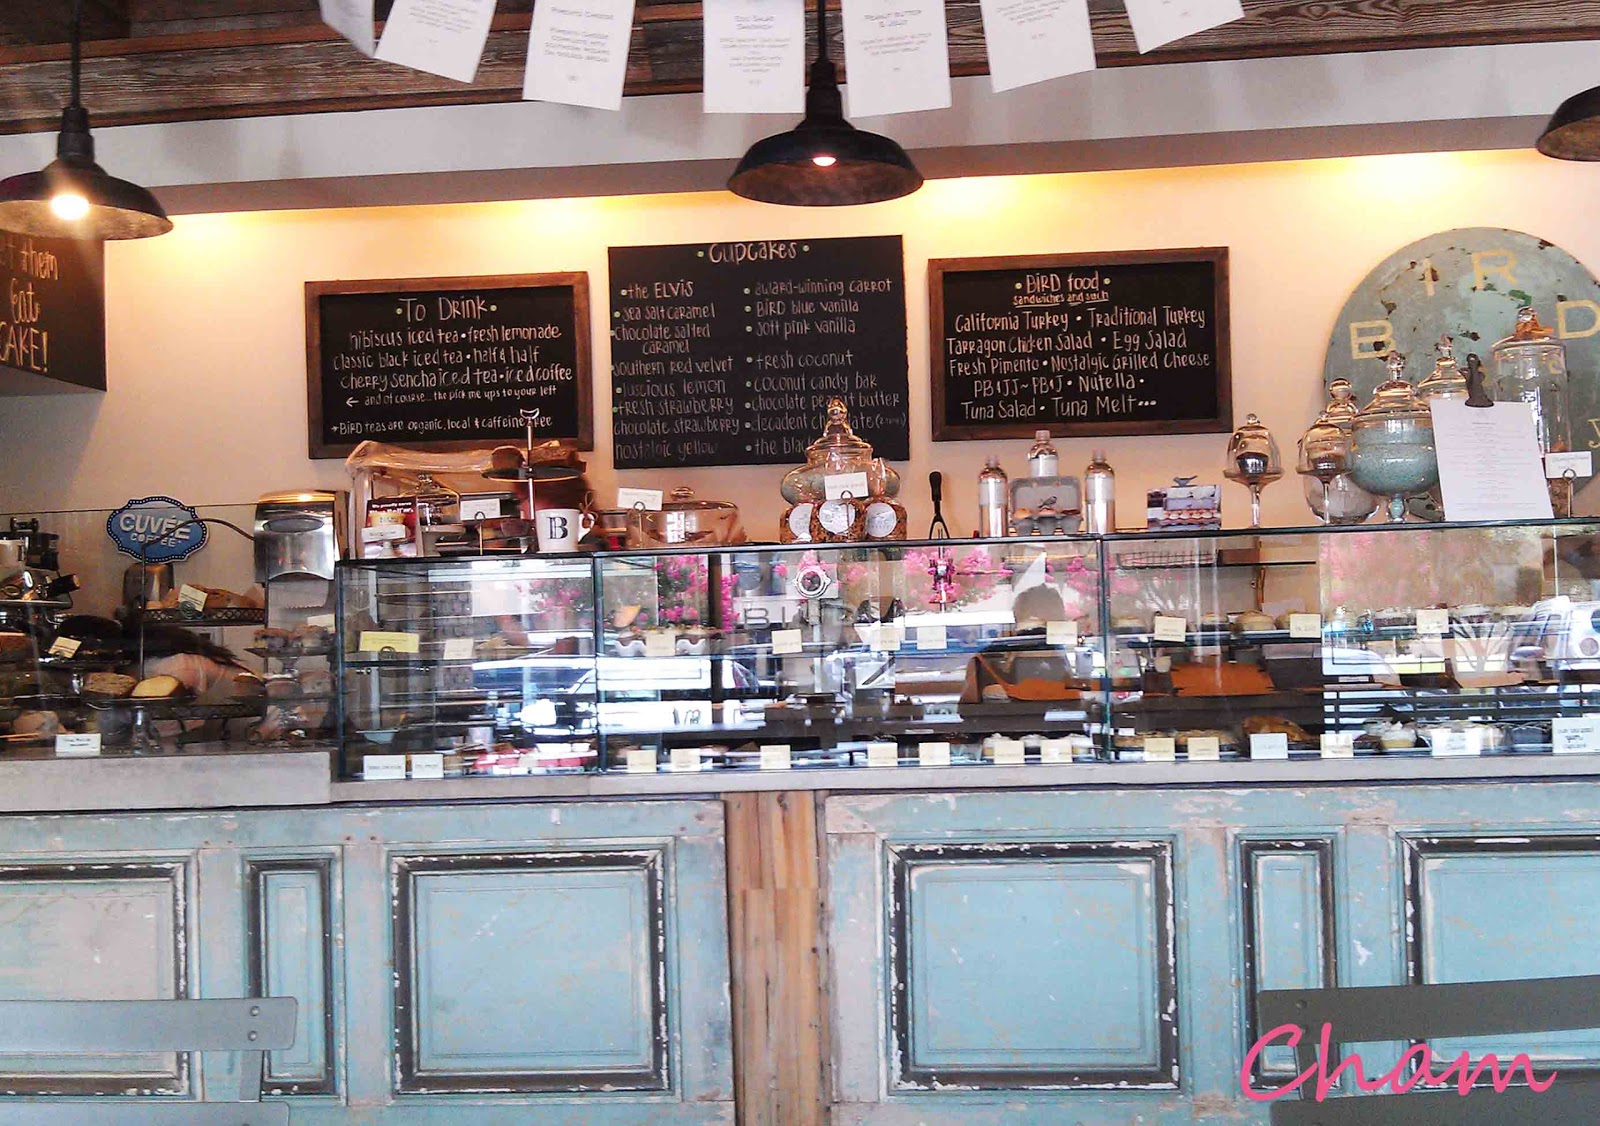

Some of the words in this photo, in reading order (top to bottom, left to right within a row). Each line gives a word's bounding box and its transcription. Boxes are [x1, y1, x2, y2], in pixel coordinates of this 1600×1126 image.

[627, 282, 650, 299] the
[849, 277, 893, 294] carrot
[1066, 271, 1100, 292] food
[791, 299, 816, 315] blue
[819, 299, 860, 315] vanilla
[1013, 292, 1065, 306] sandwiches
[1067, 291, 1084, 304] and
[399, 298, 427, 323] To
[621, 305, 641, 322] sea
[644, 304, 665, 321] salt
[666, 301, 717, 320] caramel
[954, 310, 1020, 333] California
[1022, 310, 1069, 332] Turkey
[1086, 305, 1158, 329] Traditional
[1162, 305, 1206, 329] Turkey
[350, 330, 403, 351] hibiscus
[407, 326, 435, 346] iced
[437, 328, 460, 345] tea
[467, 325, 500, 344] fresh
[501, 323, 563, 341] lemonade
[674, 322, 711, 339] salted
[756, 319, 780, 337] soft
[784, 319, 811, 341] pink
[813, 315, 857, 335] vanilla
[642, 338, 691, 356] caramel
[946, 337, 1006, 359] Tarragon
[1008, 333, 1053, 354] Chicken
[1055, 330, 1094, 351] Salad
[1113, 330, 1141, 352] Egg
[1144, 327, 1188, 350] Salad
[333, 352, 374, 371] classic
[379, 350, 409, 369] black
[413, 348, 440, 367] iced
[442, 348, 464, 365] tea
[473, 345, 499, 365] half
[510, 345, 541, 365] half
[613, 359, 665, 378] southern
[670, 357, 693, 375] red
[695, 355, 734, 374] velvet
[757, 350, 794, 370] fresh
[798, 349, 854, 368] coconut
[949, 357, 987, 377] Fresh
[990, 357, 1041, 375] Pimento
[1050, 352, 1109, 375] Nostalgic
[1112, 351, 1159, 371] Grilled
[1163, 350, 1211, 369] Cheese
[438, 366, 471, 388] iced
[472, 367, 498, 386] tea
[505, 364, 535, 384] iced
[535, 361, 574, 382] coffee
[753, 371, 805, 393] coconut
[810, 372, 849, 392] candy
[1079, 372, 1136, 393] Nutella
[364, 393, 382, 406] and
[383, 393, 394, 406] of
[433, 389, 448, 401] the
[449, 388, 467, 402] pick
[468, 388, 482, 400] me
[484, 387, 501, 402] ups
[502, 387, 513, 399] to
[514, 386, 538, 400] your
[540, 384, 558, 397] left
[683, 379, 727, 396] lemon
[618, 397, 655, 416] fresh
[659, 396, 735, 416] strawberry
[751, 392, 806, 411] chocolate
[811, 391, 855, 411] peaut
[859, 389, 900, 408] butter
[960, 400, 995, 420] Tuna
[998, 397, 1037, 418] Salad
[1050, 396, 1089, 416] Tuna
[388, 419, 404, 431] are
[446, 415, 471, 430] local
[481, 414, 526, 430] caffeine
[530, 415, 554, 429] ree
[613, 418, 670, 437] chocolate
[673, 416, 741, 437] strawberry
[750, 411, 808, 432] decadent
[678, 440, 719, 462] yellow
[754, 437, 778, 457] the
[546, 515, 569, 540] B
